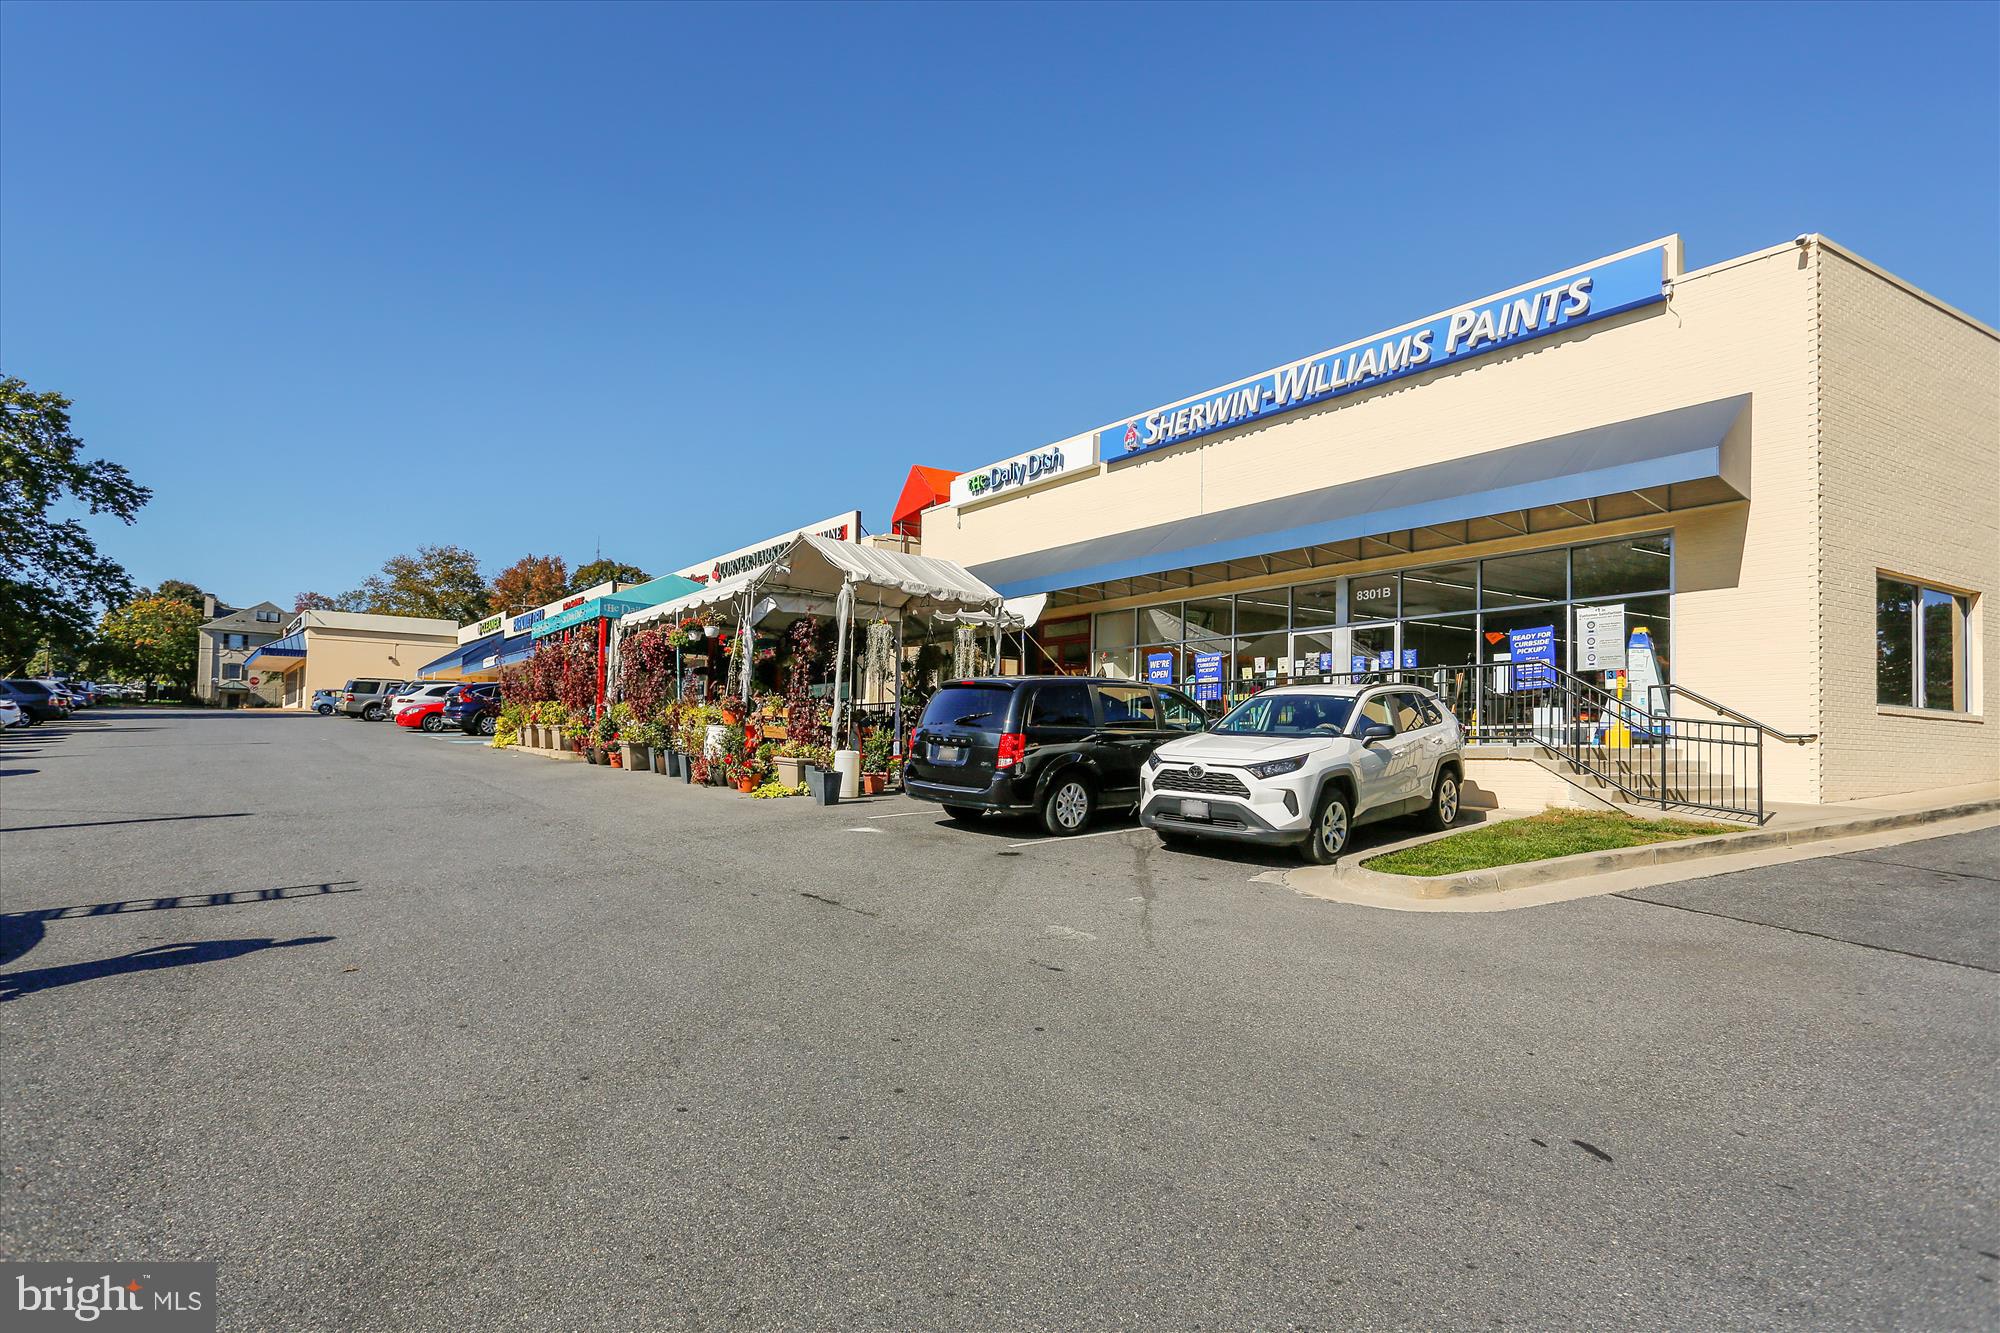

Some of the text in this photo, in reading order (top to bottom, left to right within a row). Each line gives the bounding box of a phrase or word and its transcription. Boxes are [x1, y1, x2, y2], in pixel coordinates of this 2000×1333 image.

[1142, 276, 1592, 447] SHERWIN-WILLIAMS PAINTS
[990, 462, 1026, 489] Daily
[1027, 447, 1064, 477] Dish
[1356, 587, 1391, 601] 8301B
[1512, 631, 1552, 641] READY FOR
[1514, 638, 1550, 648] CURBSIDE
[1516, 646, 1547, 655] PICKUP?
[1149, 660, 1170, 669] WE'RE
[1151, 670, 1169, 679] OPEN
[1608, 670, 1614, 680] 3
